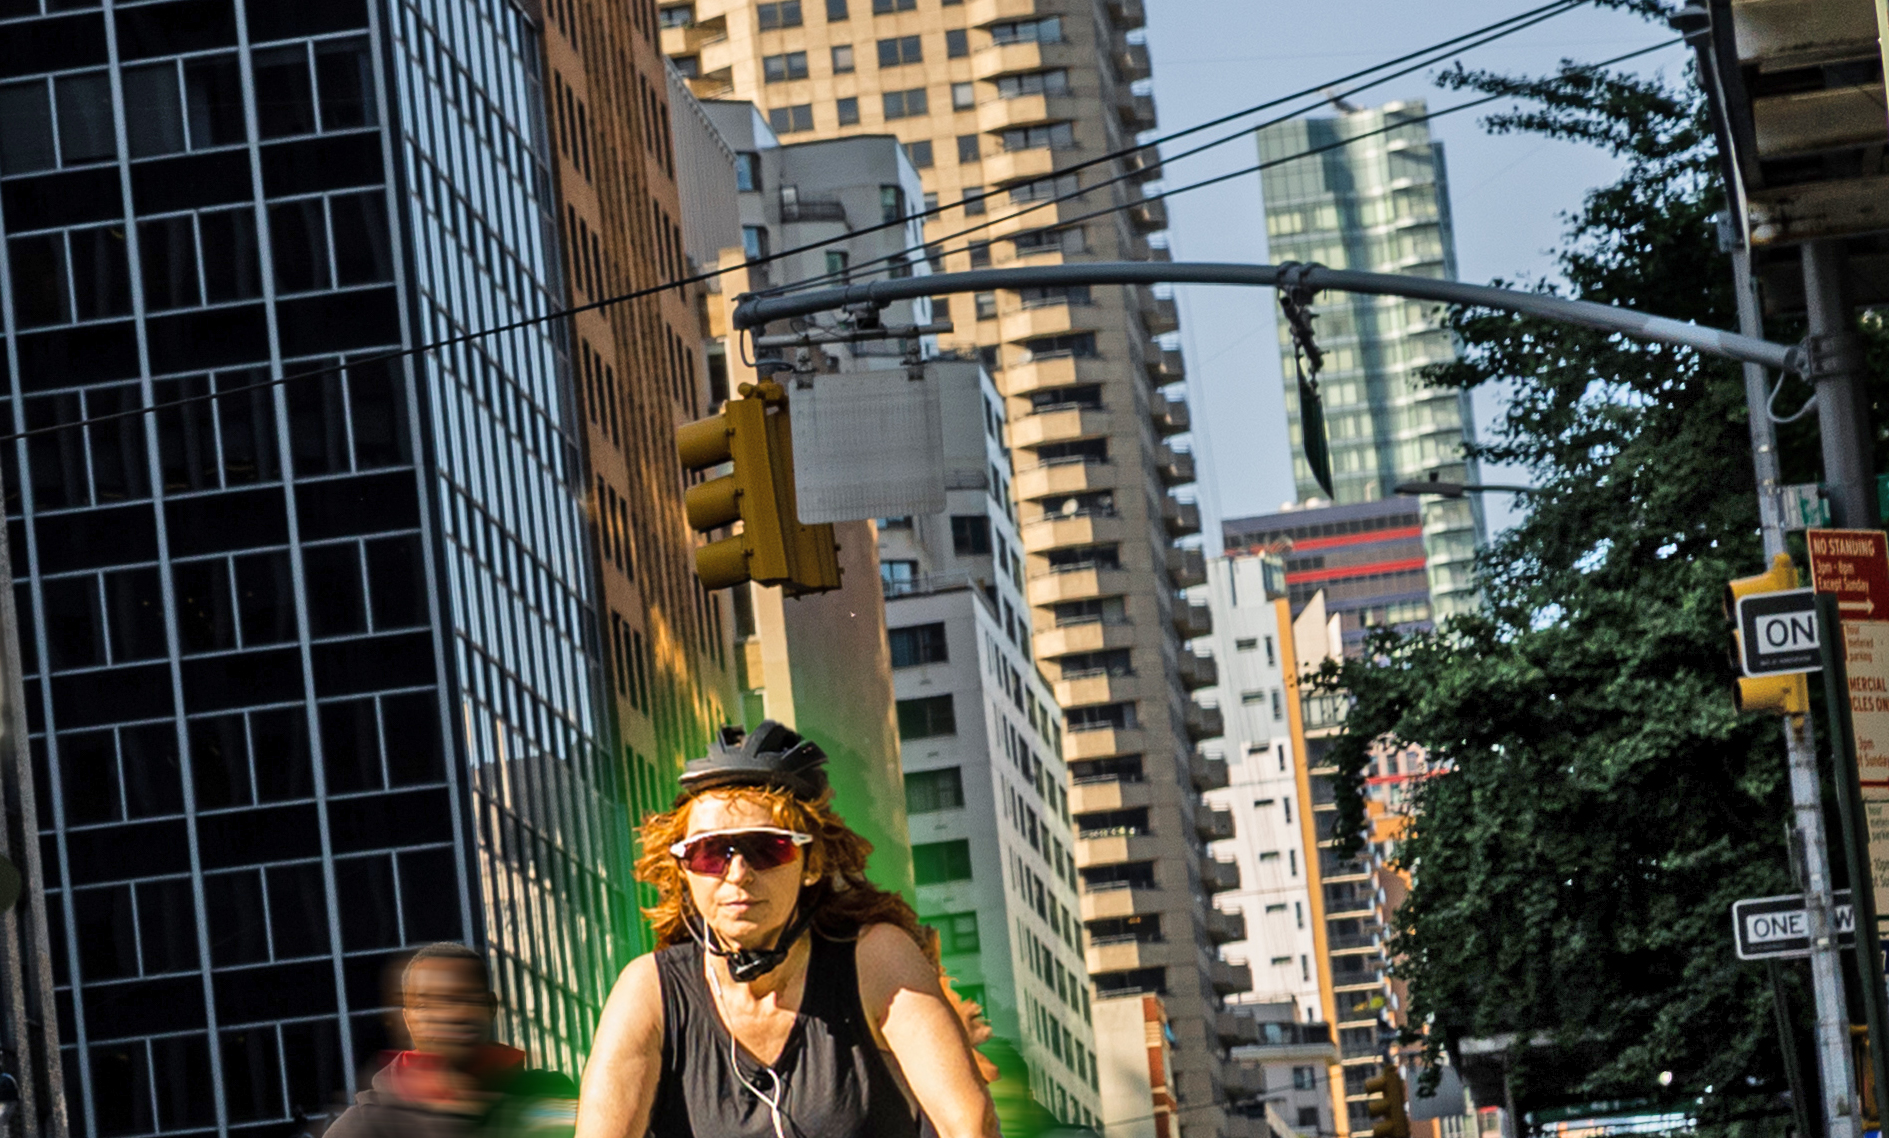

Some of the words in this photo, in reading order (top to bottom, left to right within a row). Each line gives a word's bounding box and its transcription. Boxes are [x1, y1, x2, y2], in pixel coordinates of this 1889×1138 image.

[1813, 538, 1827, 555] NO
[1829, 538, 1875, 557] STANDING
[1844, 576, 1869, 594] Sunday
[1754, 914, 1804, 938] ONE
